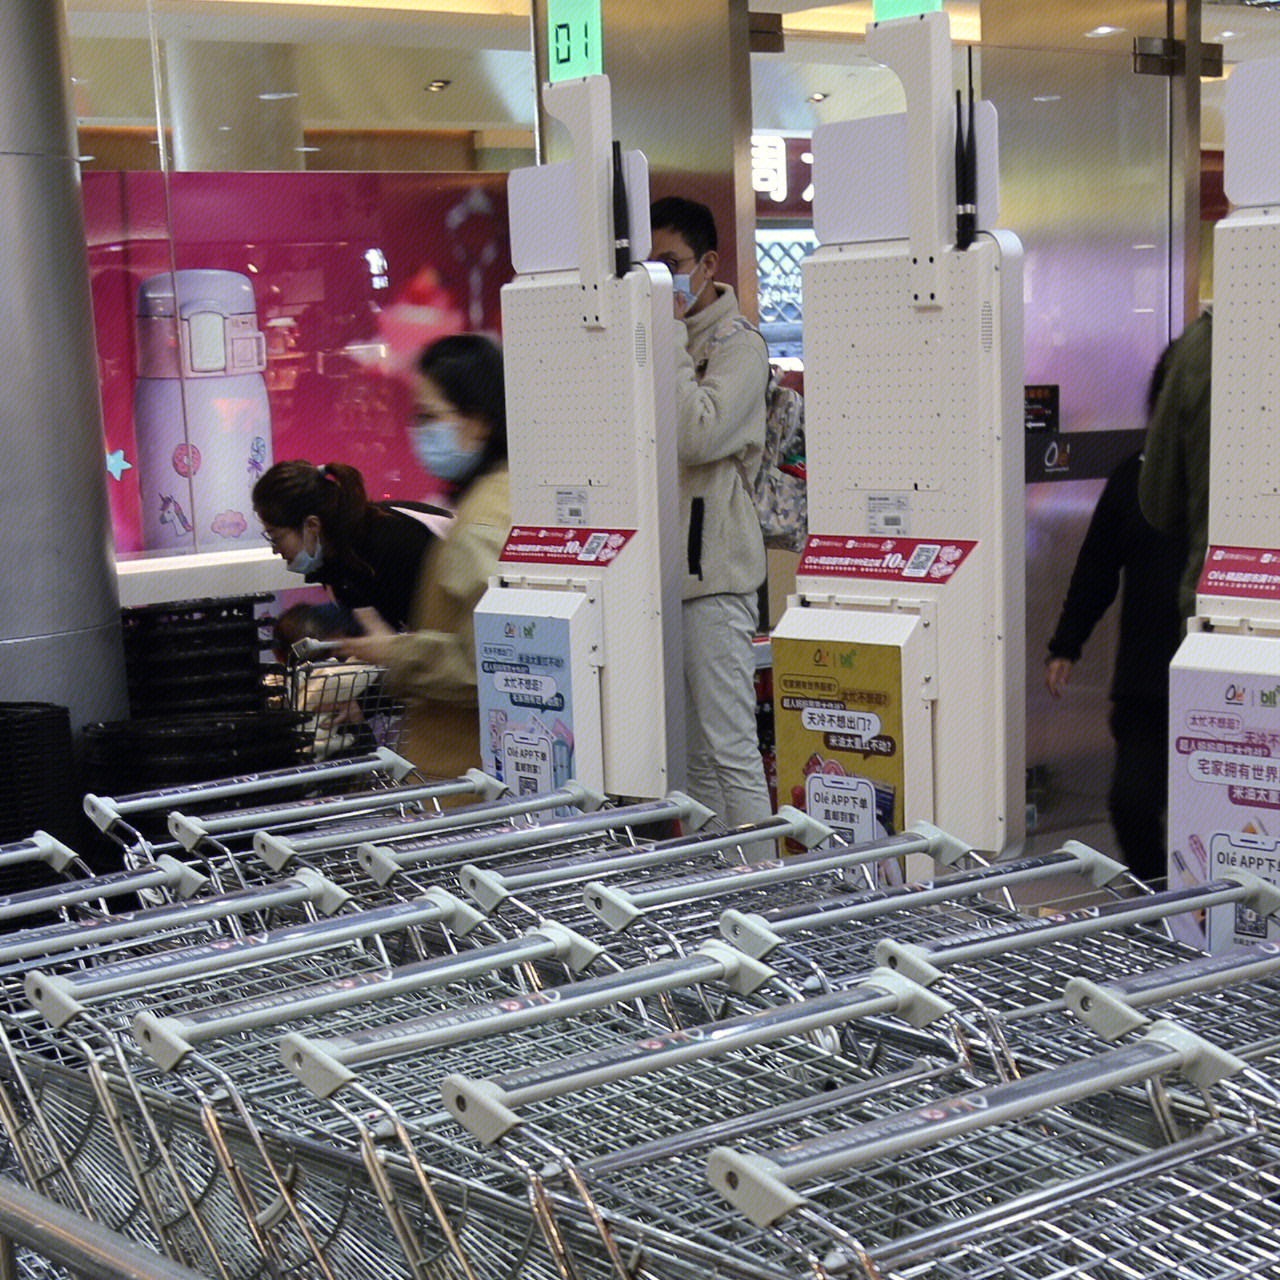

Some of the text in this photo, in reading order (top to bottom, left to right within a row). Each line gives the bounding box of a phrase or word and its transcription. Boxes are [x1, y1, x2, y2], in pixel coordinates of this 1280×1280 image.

[555, 21, 589, 65] 01
[807, 712, 872, 731] 天冷不想出门？
[814, 791, 868, 809] Olé APP下单
[1217, 851, 1237, 866] Olé
